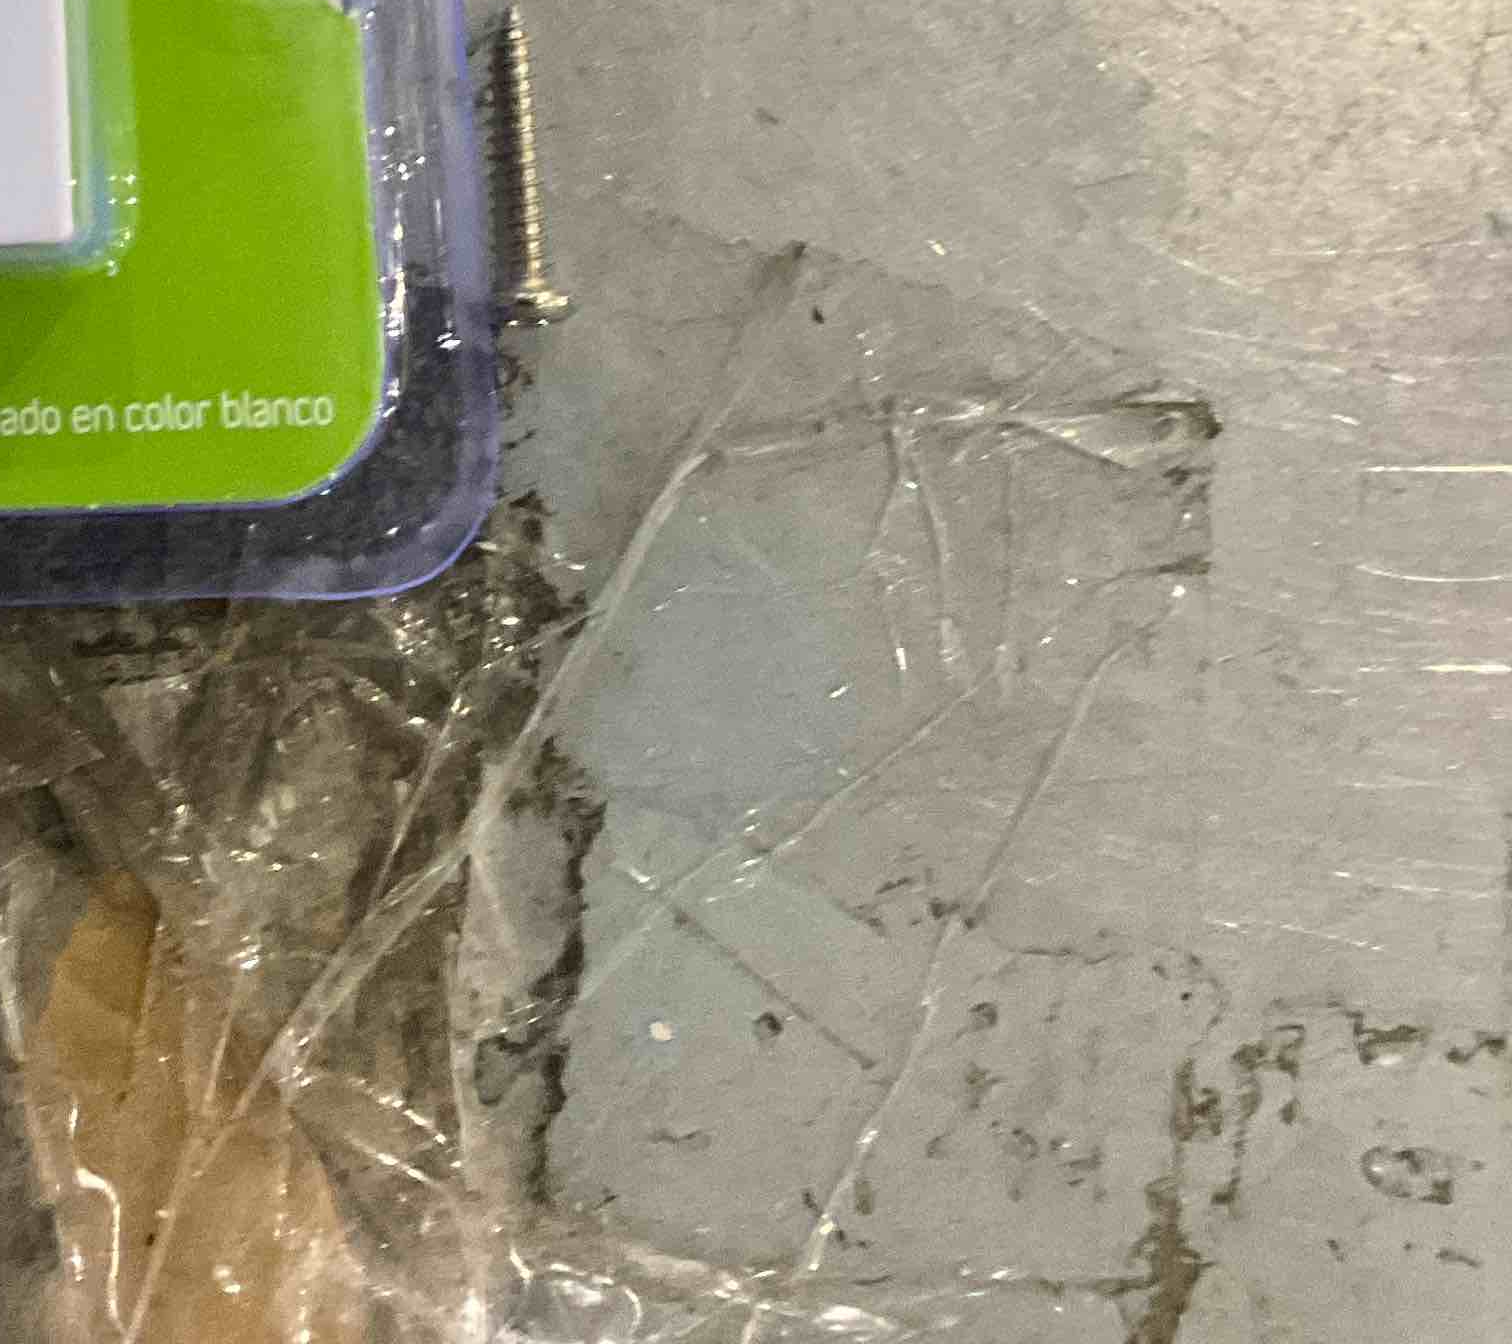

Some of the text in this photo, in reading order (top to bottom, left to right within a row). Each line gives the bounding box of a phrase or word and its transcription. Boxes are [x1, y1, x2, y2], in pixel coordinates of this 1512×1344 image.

[71, 404, 114, 433] en
[125, 393, 211, 433] color
[220, 391, 335, 430] blanco
